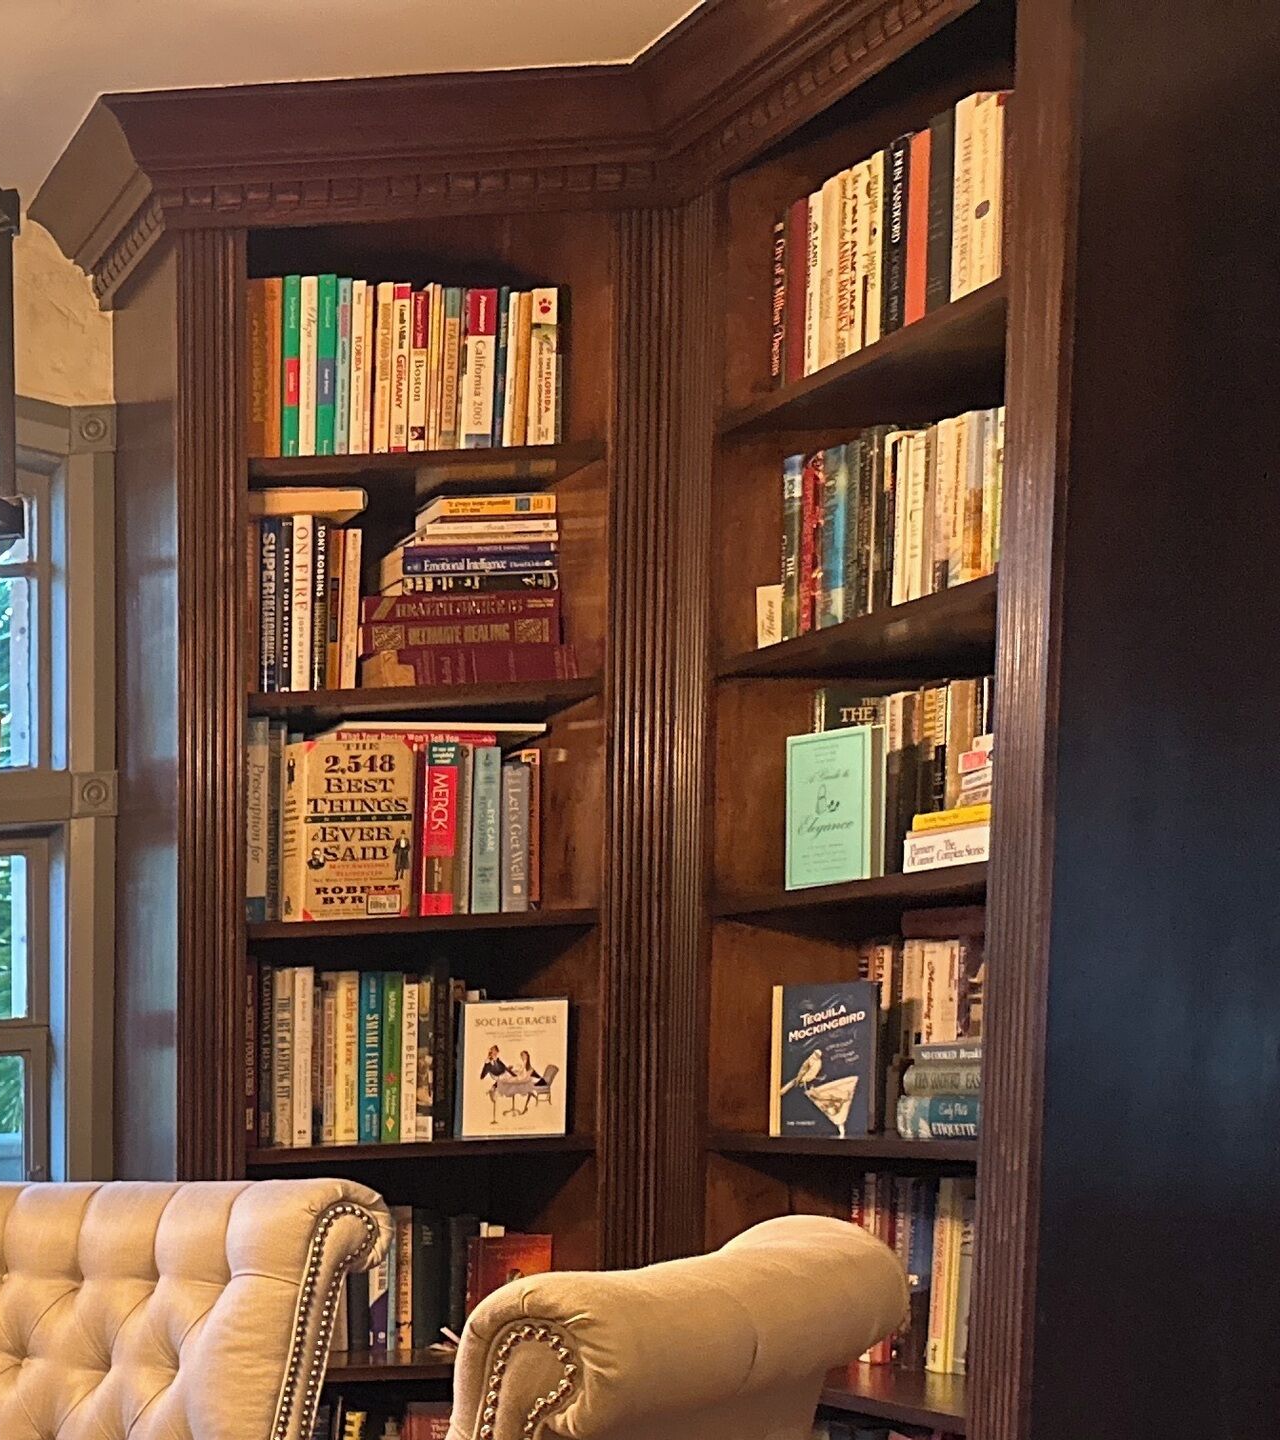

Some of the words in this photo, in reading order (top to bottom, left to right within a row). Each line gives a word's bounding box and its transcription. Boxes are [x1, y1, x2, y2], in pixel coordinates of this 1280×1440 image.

[890, 182, 903, 243] SANDFORD
[811, 235, 819, 268] LAND
[836, 278, 850, 333] ROONEY
[354, 336, 362, 372] FLORIDA
[447, 321, 458, 370] ITALIAN
[395, 354, 406, 409] GERMANY
[413, 359, 425, 402] Boston
[473, 340, 486, 397] California
[444, 374, 455, 425] ODYSSEY
[472, 401, 483, 426] 2005
[295, 526, 309, 555] ON
[317, 525, 326, 552] TONY
[316, 555, 325, 597] ROBBINS
[423, 558, 466, 572] Emotional
[466, 557, 508, 573] Intelligence
[294, 564, 308, 611] FIRE
[342, 742, 379, 751] THE
[406, 733, 430, 743] Won't
[430, 733, 444, 743] Tell
[324, 754, 396, 775] 2,548
[250, 764, 266, 833] Prescription
[324, 777, 395, 794] BEST
[306, 798, 409, 814] THINGS
[431, 772, 449, 831] MERCK
[508, 788, 522, 822] Let's
[319, 826, 395, 843] EVER
[487, 826, 496, 852] CARE
[510, 823, 522, 849] Get
[798, 816, 855, 840] Elegance
[250, 841, 264, 864] for
[323, 845, 390, 863] SAID
[936, 848, 964, 862] Complete
[964, 845, 985, 858] Stories
[944, 839, 955, 850] The
[511, 850, 525, 881] Well
[322, 895, 365, 905] BYR
[279, 996, 291, 1017] THE
[342, 981, 357, 1020] Healthy
[406, 989, 416, 1037] WHEAT
[277, 1018, 291, 1033] ART
[345, 1023, 355, 1032] at
[474, 1017, 515, 1027] SOCIAL
[516, 1015, 557, 1025] GRACES
[788, 1010, 866, 1043] MOCKINGBIRD
[800, 1004, 847, 1027] TEQUILA
[365, 1013, 379, 1049] SMART
[245, 1041, 254, 1067] FOOD
[344, 1034, 356, 1066] Home
[277, 1046, 290, 1083] KEEPING
[364, 1052, 379, 1099] EXERCISE
[405, 1045, 415, 1086] BELLY
[276, 1085, 289, 1100] FIT
[931, 1123, 978, 1139] ETIQUETTE
